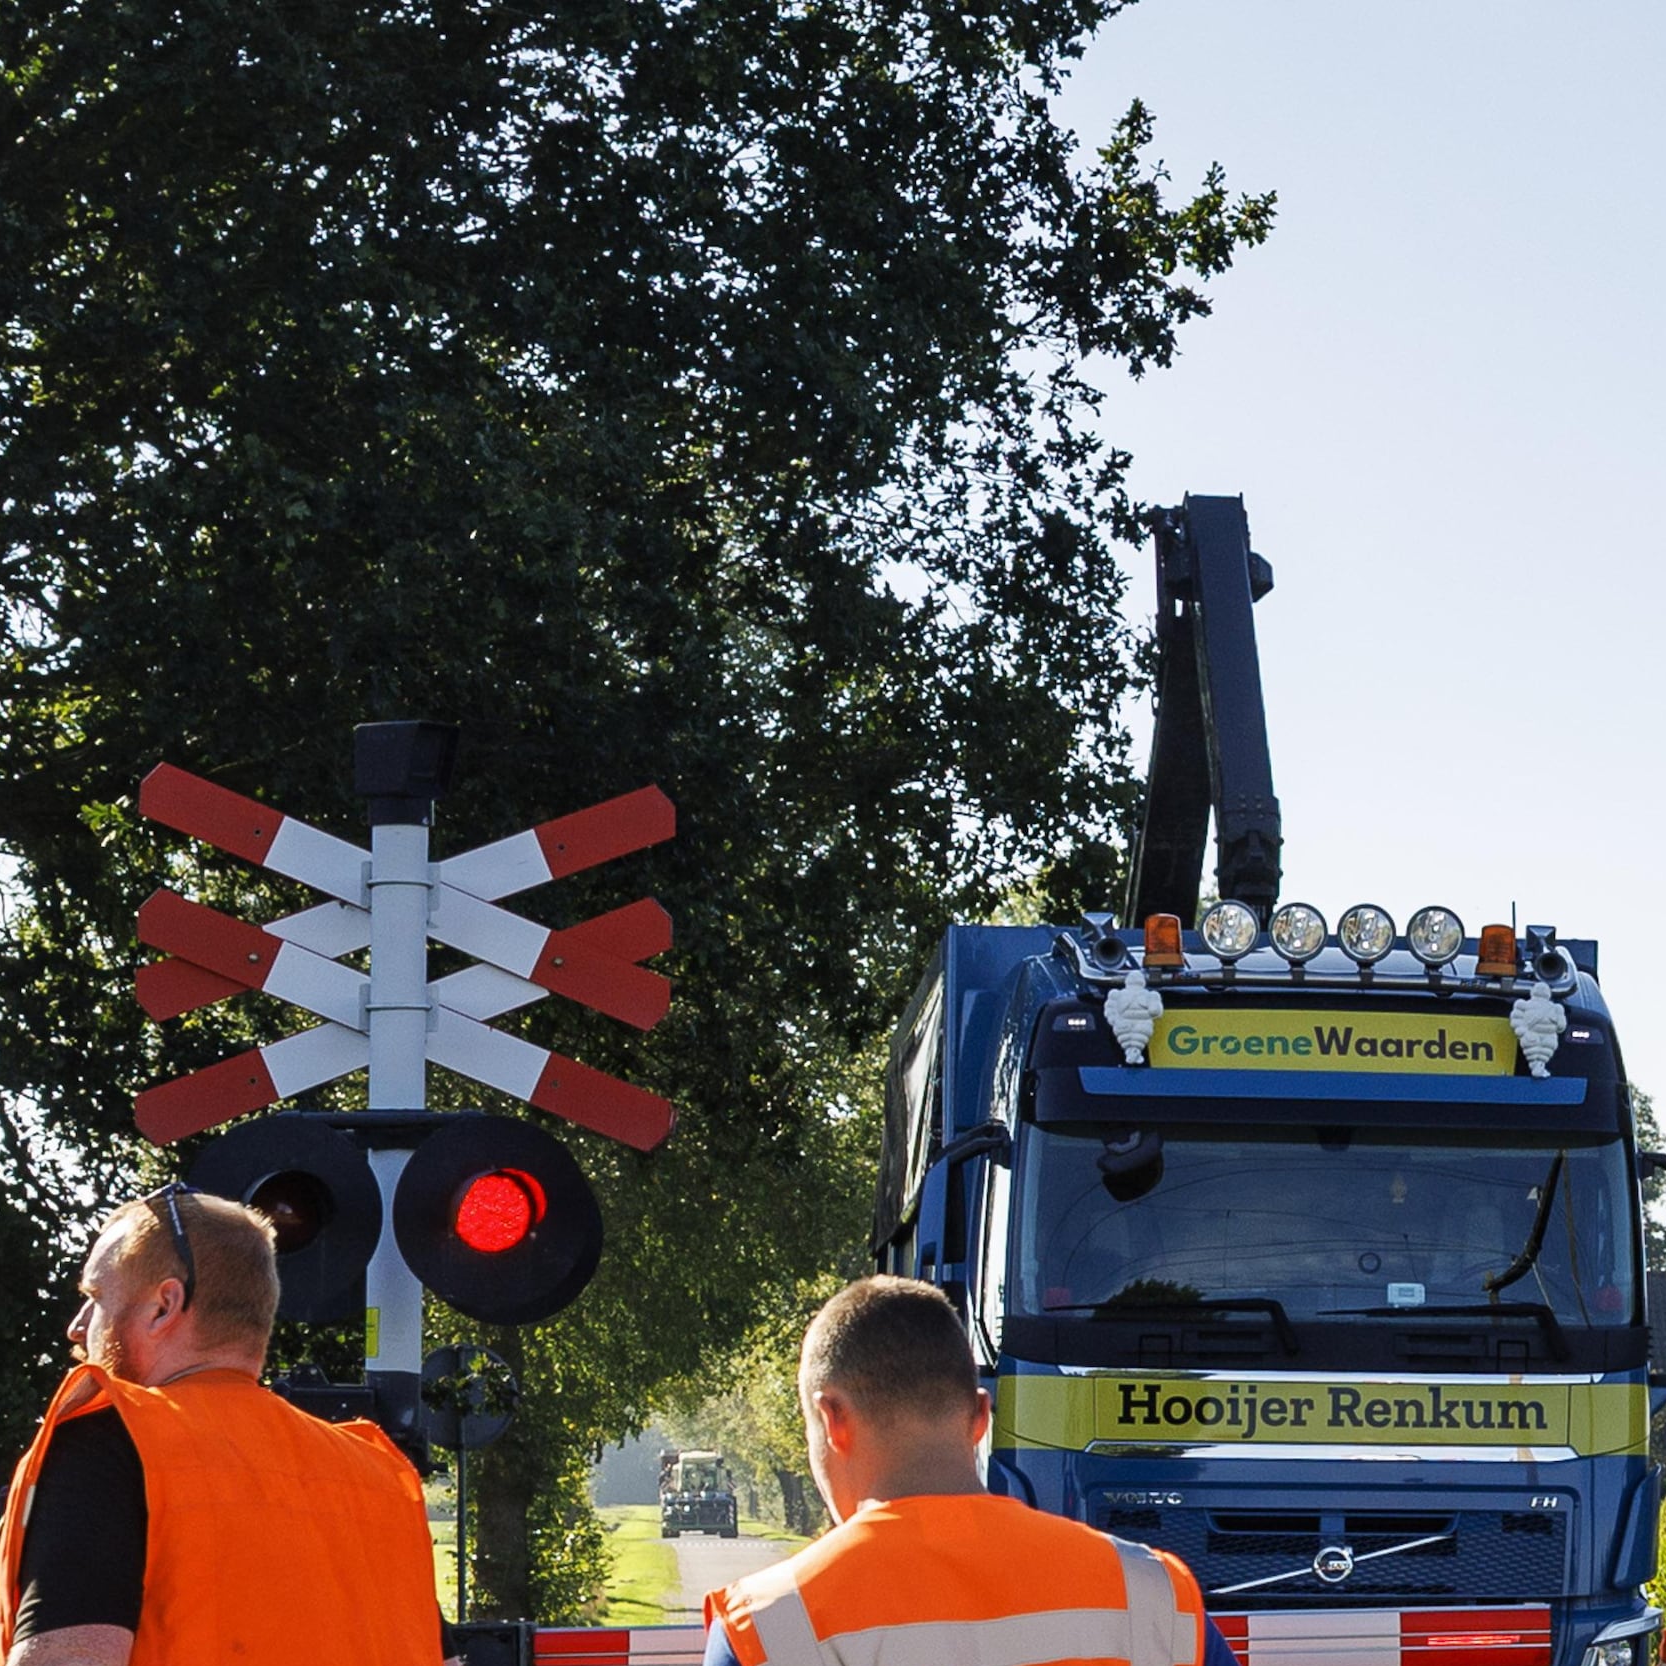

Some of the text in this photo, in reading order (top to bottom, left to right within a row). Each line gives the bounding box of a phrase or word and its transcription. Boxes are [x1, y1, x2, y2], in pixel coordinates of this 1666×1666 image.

[1167, 1025, 1494, 1062] GroeneWaarden
[1117, 1383, 1548, 1439] Hooijer Renkum
